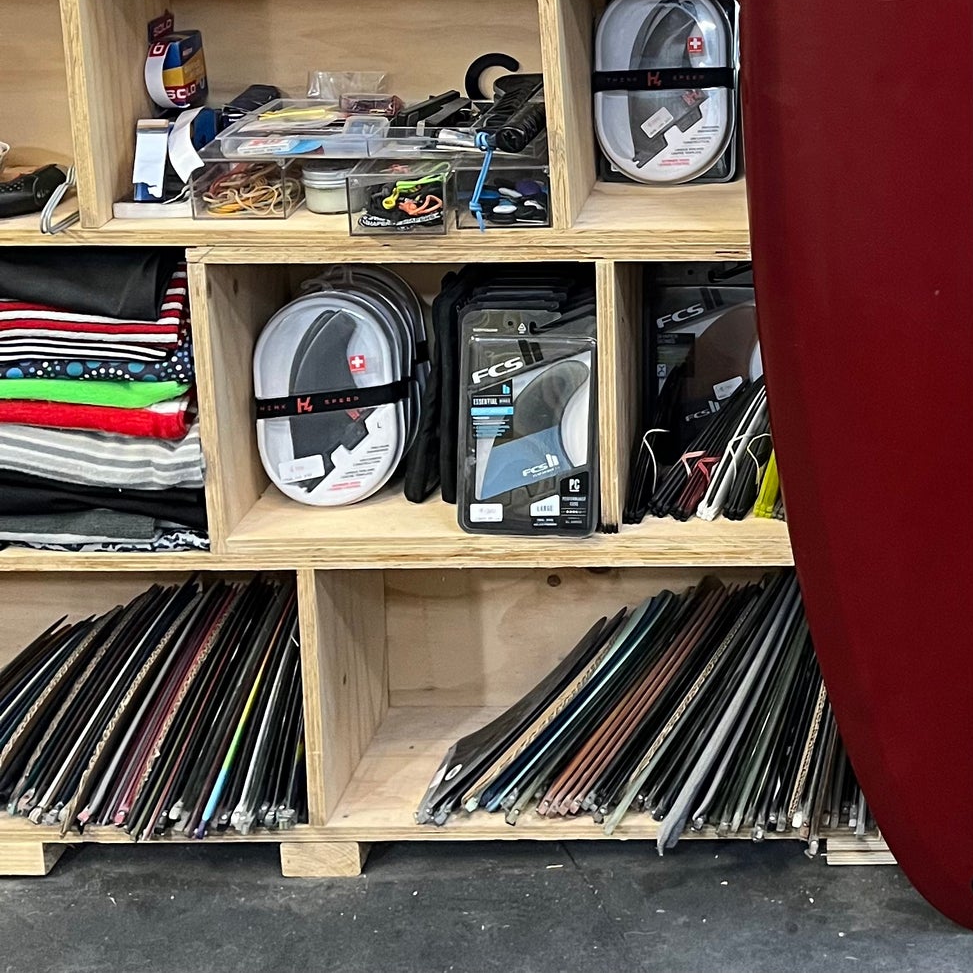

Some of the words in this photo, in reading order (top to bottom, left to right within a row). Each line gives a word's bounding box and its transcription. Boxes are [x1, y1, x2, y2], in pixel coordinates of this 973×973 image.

[656, 303, 704, 330] FCS
[472, 356, 524, 384] FCS
[685, 409, 711, 422] FCS
[522, 462, 549, 477] FCS
[569, 478, 581, 490] PC
